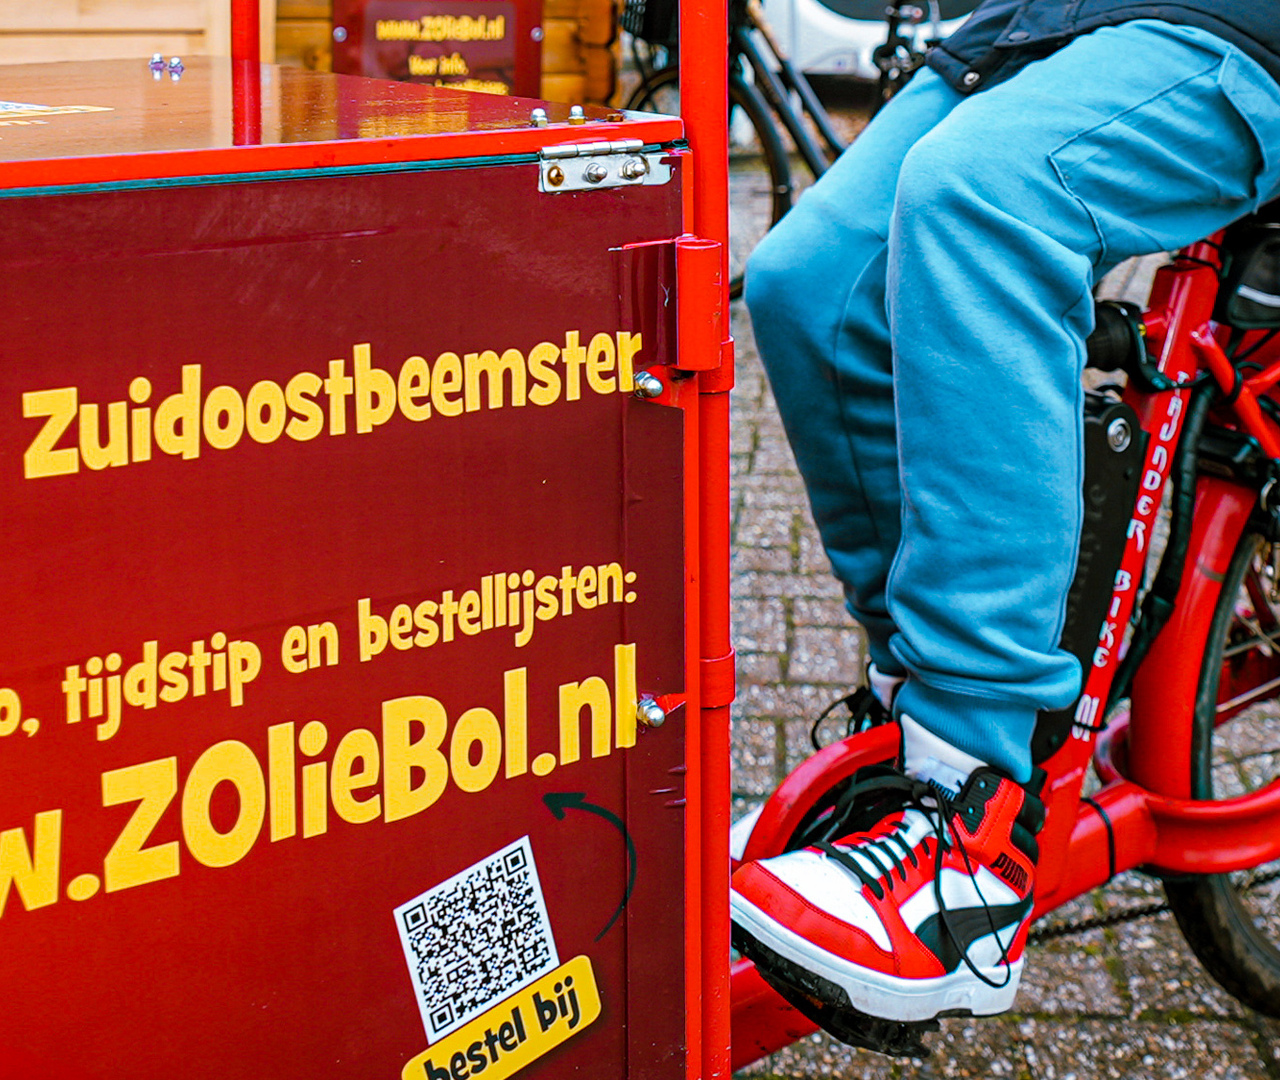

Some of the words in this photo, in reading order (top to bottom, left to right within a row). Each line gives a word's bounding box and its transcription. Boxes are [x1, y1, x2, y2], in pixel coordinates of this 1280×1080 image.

[21, 329, 643, 480] Zuidoostbeemster
[61, 631, 261, 741] tijdstip
[282, 620, 339, 675] en
[358, 558, 638, 663] bestellijsten:
[424, 1006, 527, 1080] bestel
[532, 975, 574, 1034] bij
